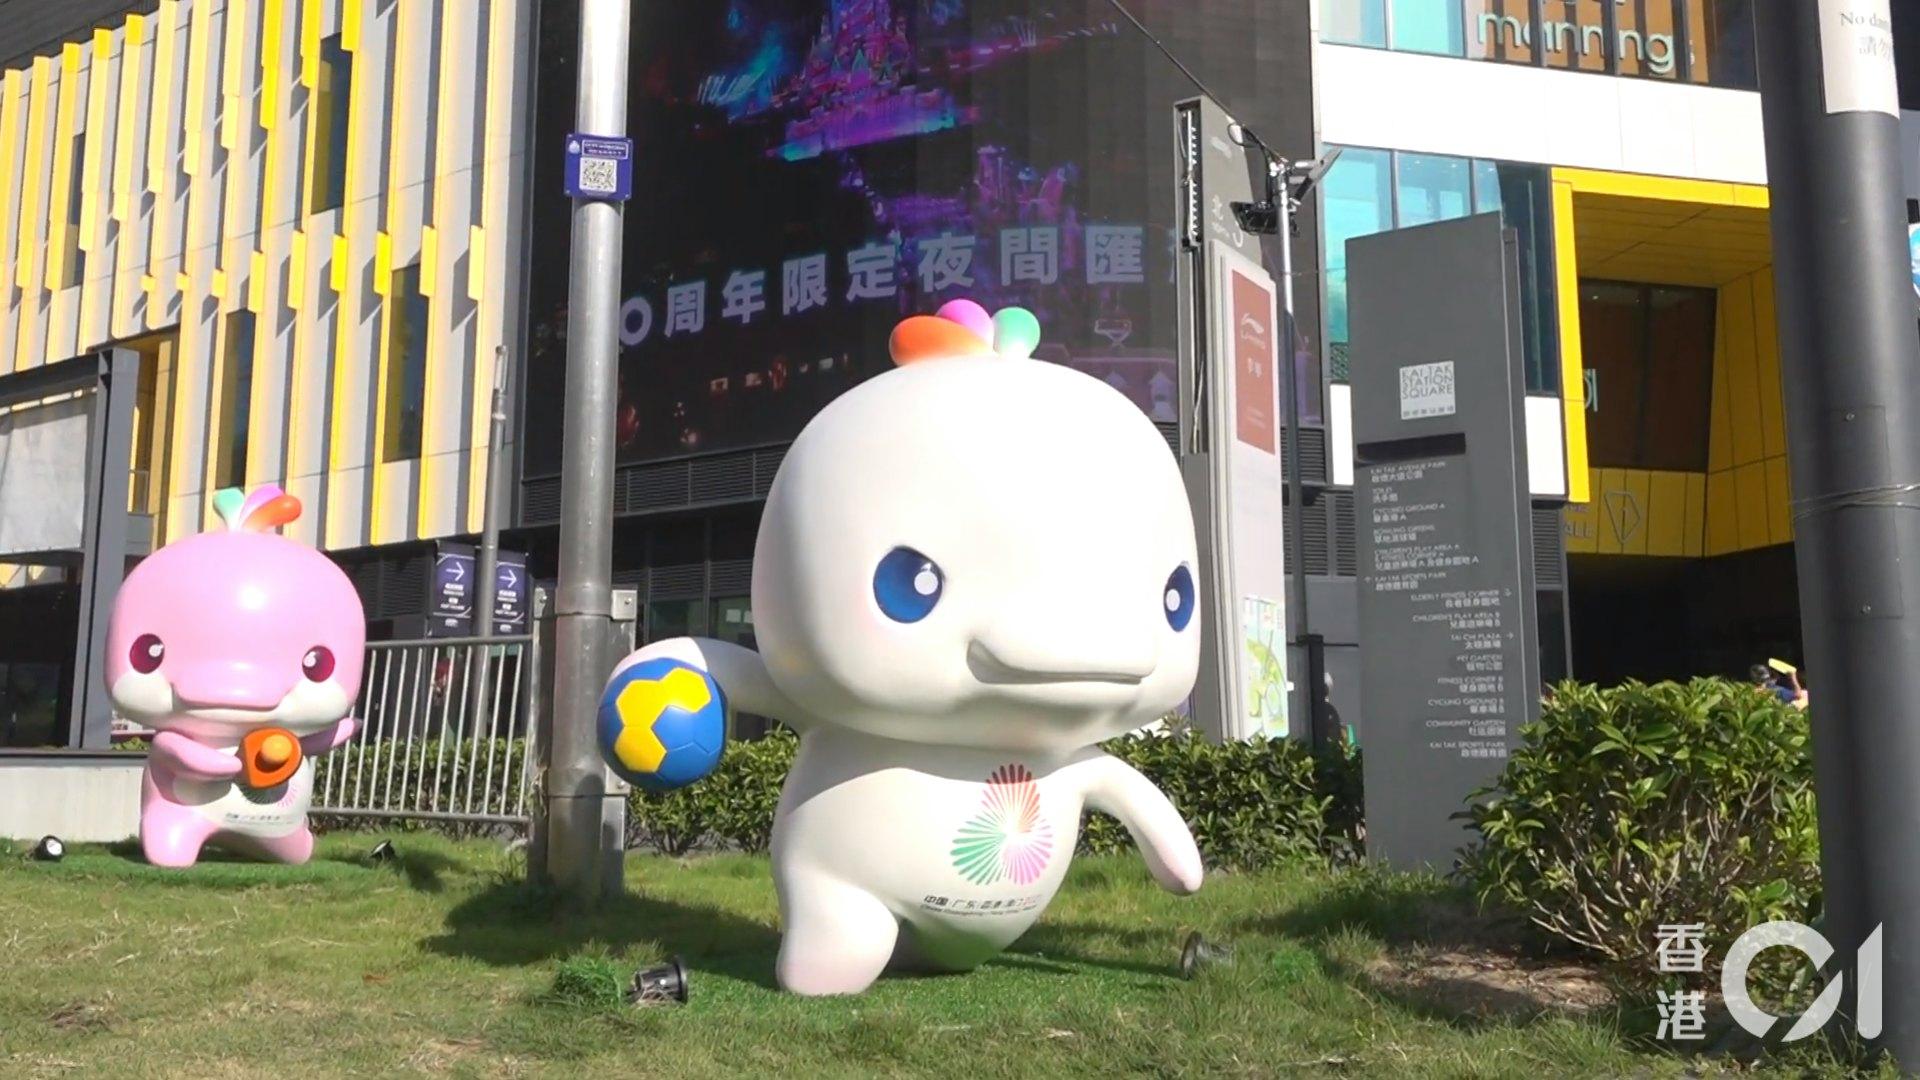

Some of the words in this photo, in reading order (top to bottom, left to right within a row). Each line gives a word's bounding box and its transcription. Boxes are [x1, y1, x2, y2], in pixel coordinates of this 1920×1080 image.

[1840, 13, 1865, 27] No
[618, 226, 1175, 346] 0周年限定夜間匯
[1402, 368, 1424, 380] KAI
[1428, 363, 1453, 375] TAK
[1402, 374, 1454, 391] STATION
[1402, 384, 1454, 399] SQUARE
[923, 894, 949, 907] 中国
